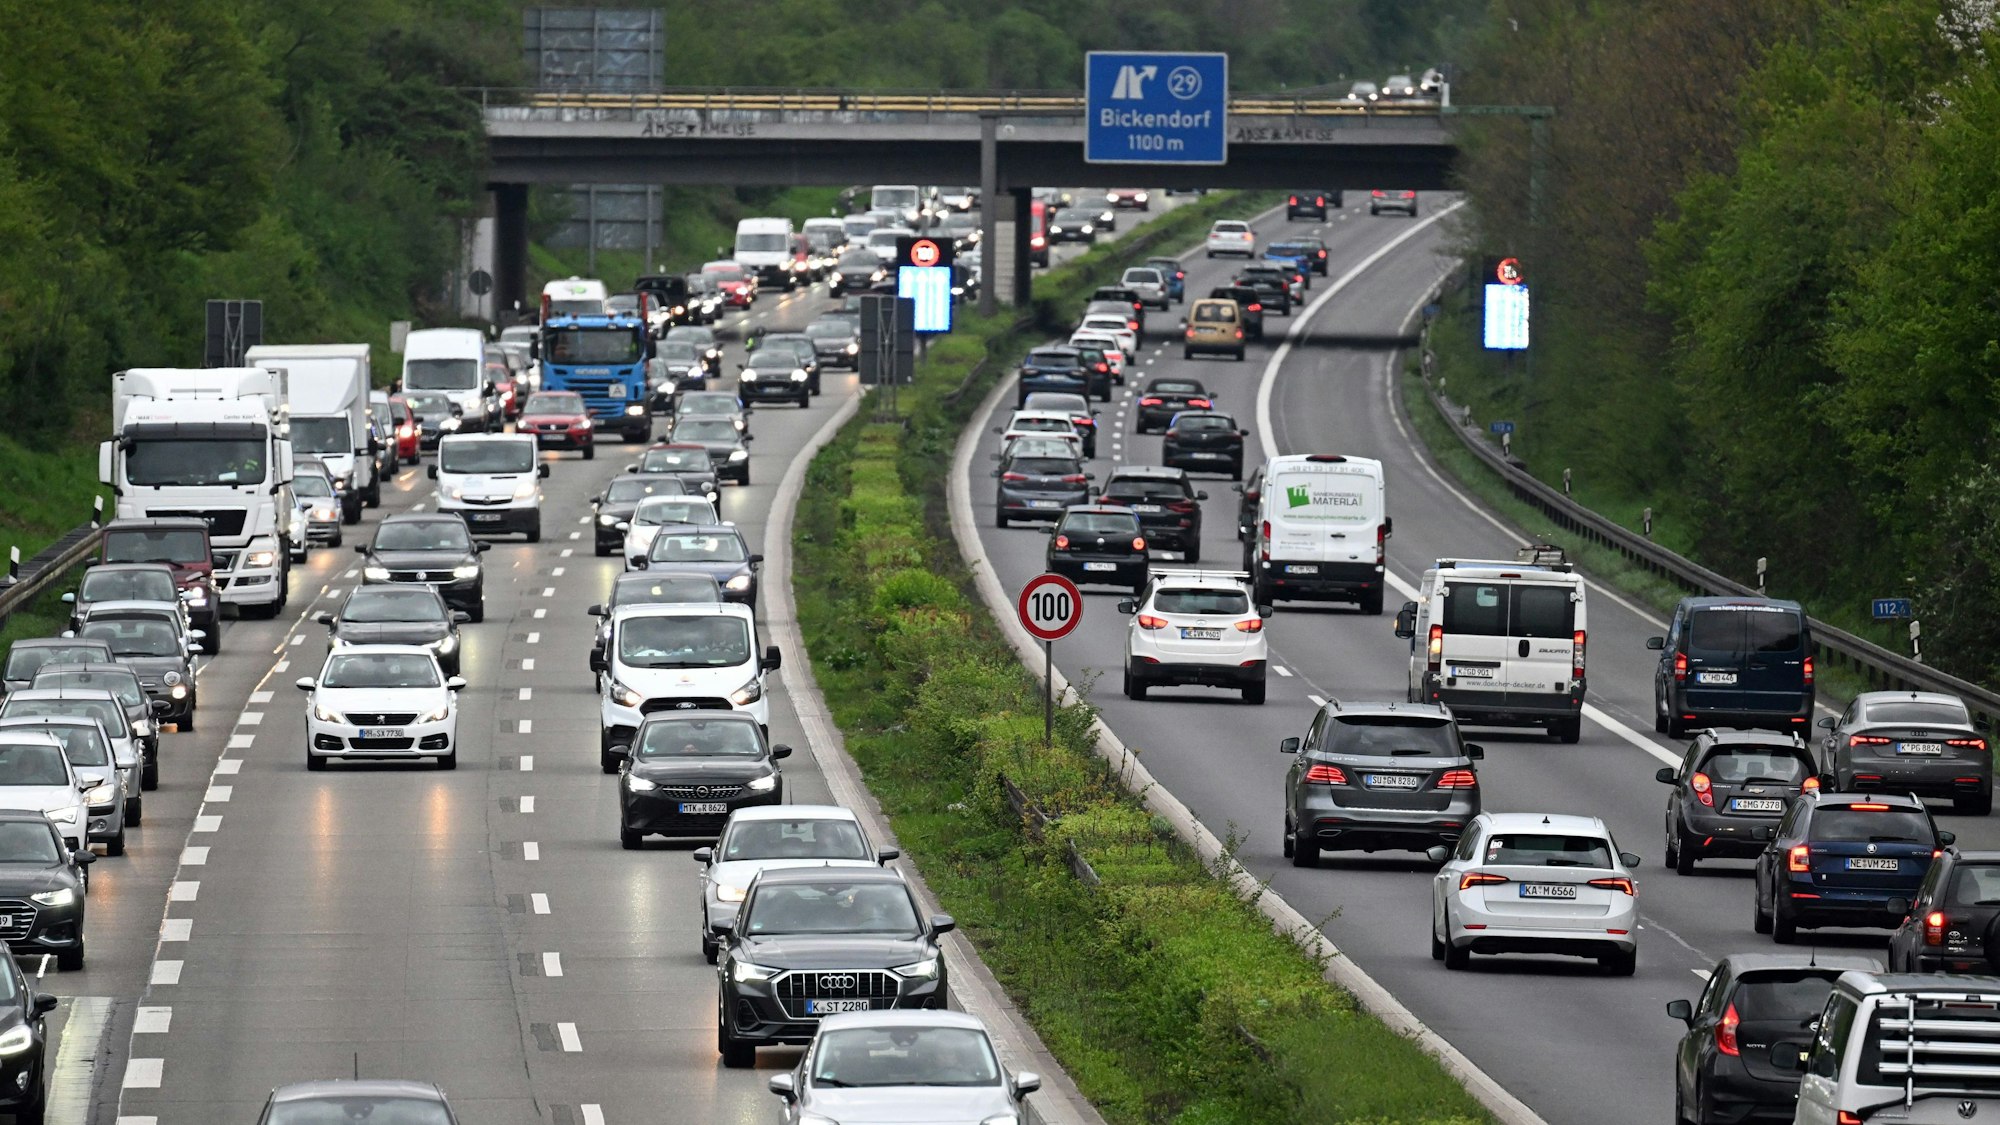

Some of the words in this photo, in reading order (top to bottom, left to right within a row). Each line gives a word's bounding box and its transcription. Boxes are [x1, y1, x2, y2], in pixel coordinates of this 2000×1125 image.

[1173, 73, 1196, 93] 29
[1100, 108, 1212, 128] Bickendorf
[1128, 134, 1164, 150] 1100
[1166, 138, 1184, 150] m
[613, 386, 624, 396] A
[1312, 497, 1359, 506] MATERLA
[1032, 592, 1069, 621] 100
[1457, 668, 1463, 676] K
[1467, 669, 1476, 677] GD
[1477, 669, 1490, 677] 901
[1466, 679, 1546, 690] www.doecher-decker.de
[1372, 776, 1382, 784] SU
[1387, 777, 1397, 785] GN
[1398, 777, 1416, 786] 8286
[683, 804, 697, 812] MTK
[702, 804, 707, 812] R
[708, 804, 726, 812] 8622
[1737, 800, 1743, 808] K
[1748, 800, 1759, 809] MG
[1760, 801, 1780, 809] 7378
[1850, 859, 1861, 868] NE
[1867, 860, 1879, 869] VM
[1880, 860, 1897, 869] 215
[1525, 885, 1538, 895] KA
[1543, 886, 1550, 895] M
[1551, 886, 1575, 896] 6566
[812, 1002, 818, 1012] K
[826, 1002, 839, 1012] ST
[842, 1002, 868, 1012] 2280
